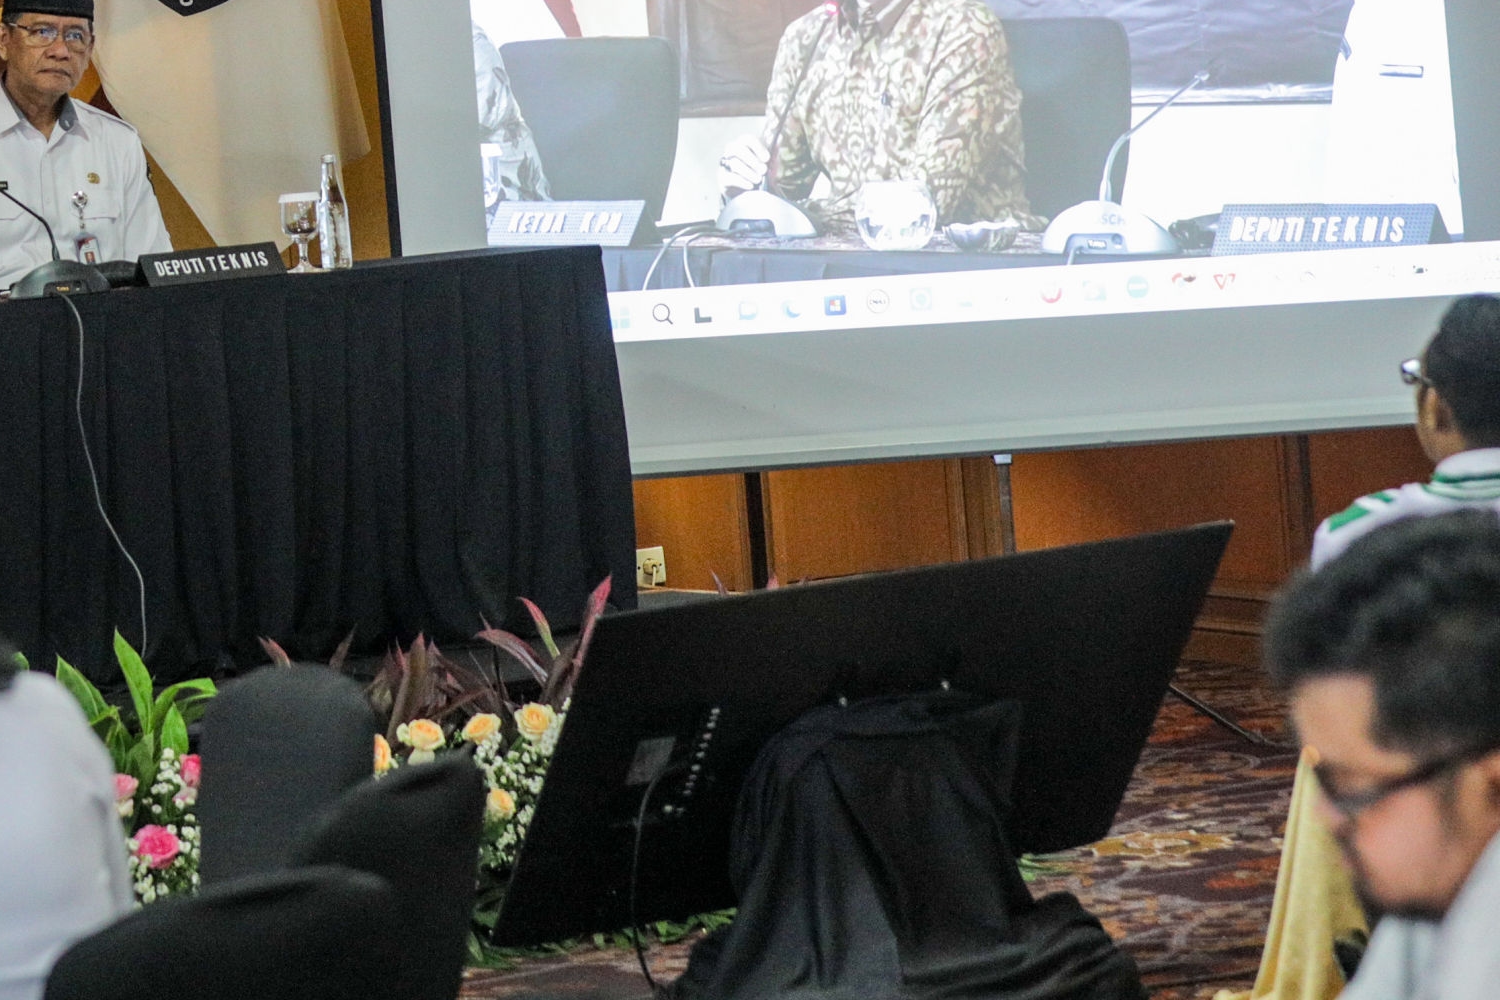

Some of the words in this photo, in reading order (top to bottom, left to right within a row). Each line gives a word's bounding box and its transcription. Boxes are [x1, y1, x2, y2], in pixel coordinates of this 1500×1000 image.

[507, 211, 567, 233] KETUA
[581, 211, 623, 233] KPU
[1229, 216, 1305, 243] DEPUTI
[1311, 216, 1405, 243] TEKNIS
[154, 257, 206, 277] DEPUTI
[206, 251, 269, 271] TEKNIS
